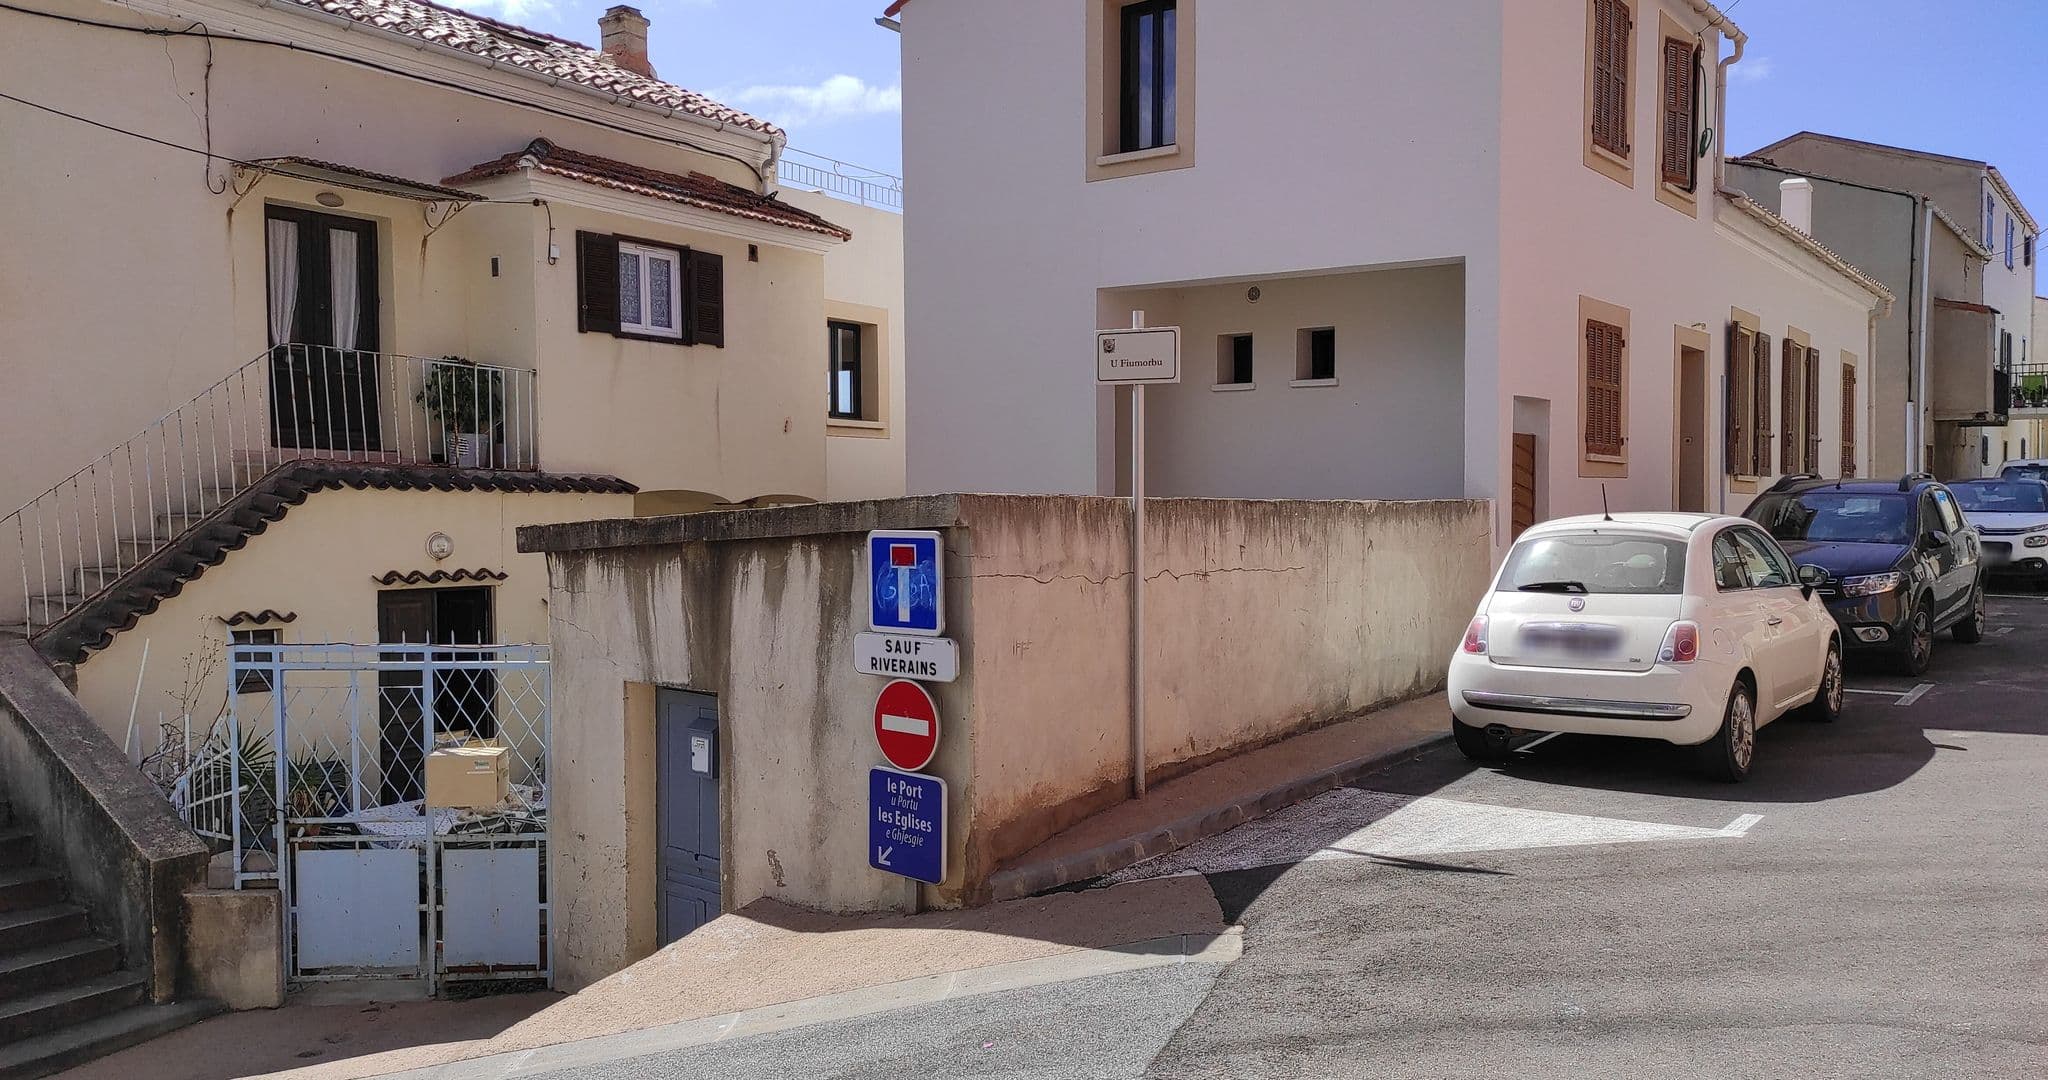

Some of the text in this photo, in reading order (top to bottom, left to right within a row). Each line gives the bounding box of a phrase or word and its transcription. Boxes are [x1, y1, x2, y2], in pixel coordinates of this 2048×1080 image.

[1110, 358, 1163, 368] U Fiumorbu
[885, 639, 921, 655] SAUF
[871, 656, 937, 676] RIVERAINS
[887, 777, 923, 799] le Port
[891, 795, 919, 811] u Portu
[878, 806, 932, 833] les Eglises
[886, 829, 891, 839] e
